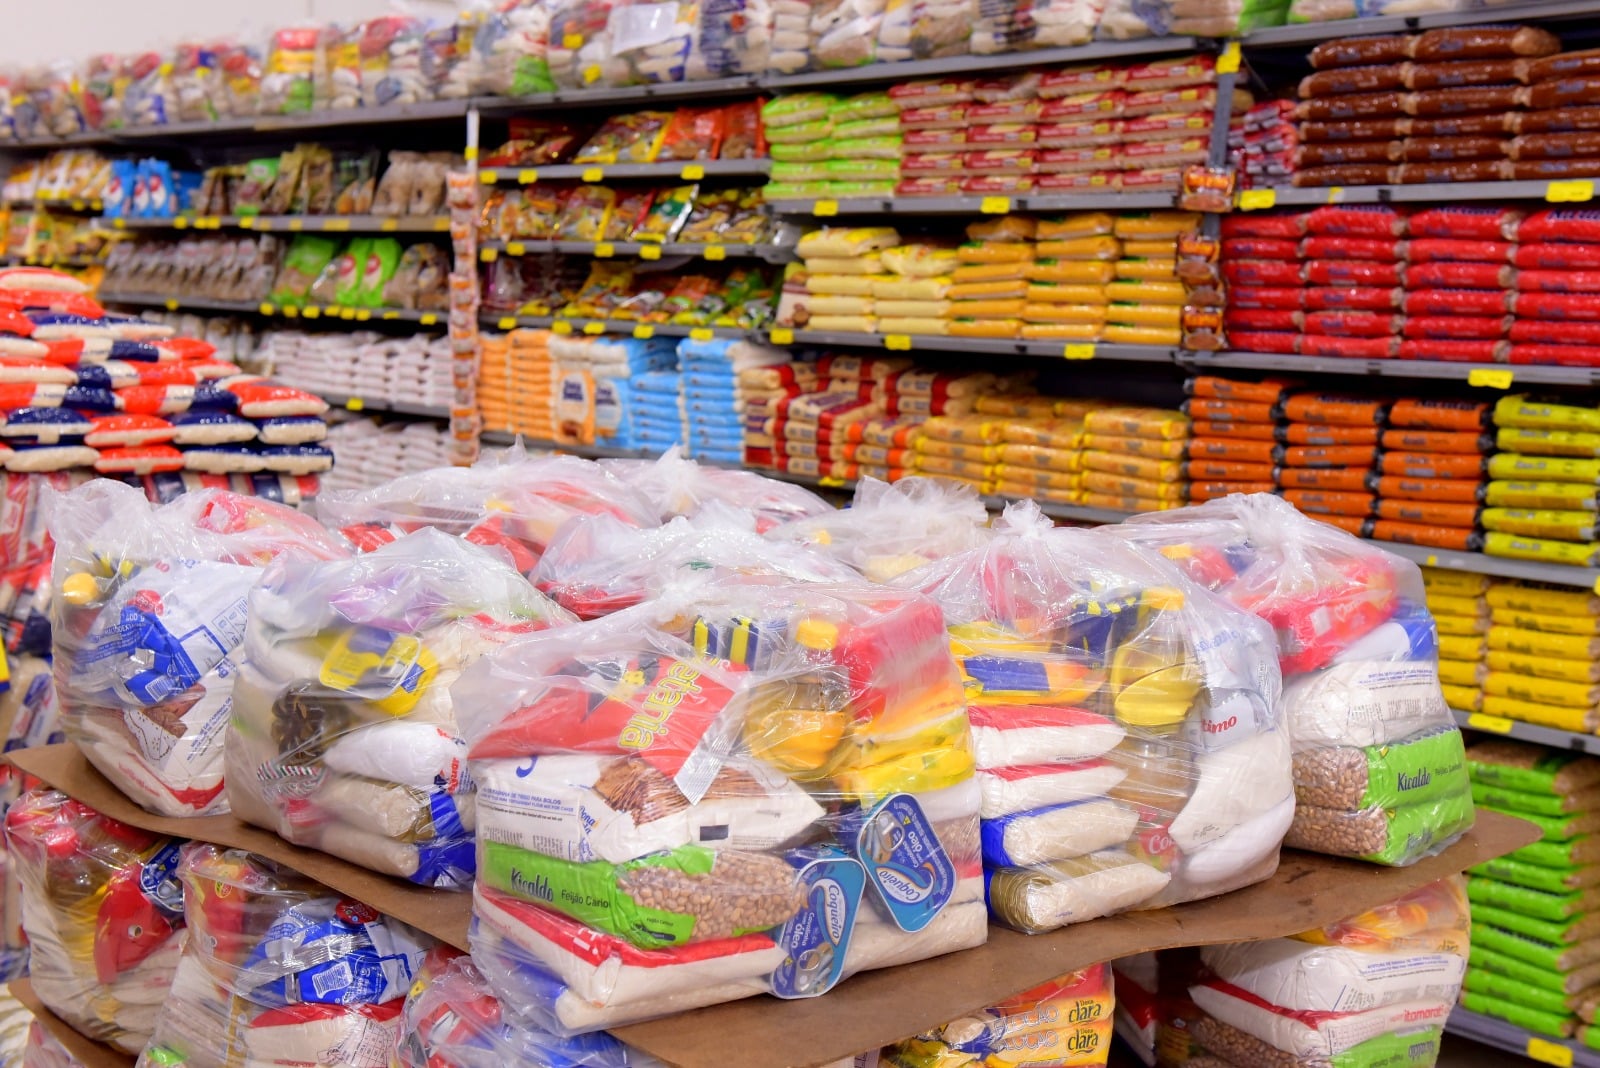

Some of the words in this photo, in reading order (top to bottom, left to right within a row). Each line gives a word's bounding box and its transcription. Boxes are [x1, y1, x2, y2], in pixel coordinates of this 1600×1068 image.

[510, 867, 555, 903] Kicaldo
[560, 889, 585, 905] Feijão
[879, 870, 921, 901] Coqueiro
[826, 884, 842, 940] Coqueiro
[790, 922, 804, 949] óleo
[1068, 1000, 1101, 1023] clara
[1067, 1028, 1100, 1051] clara
